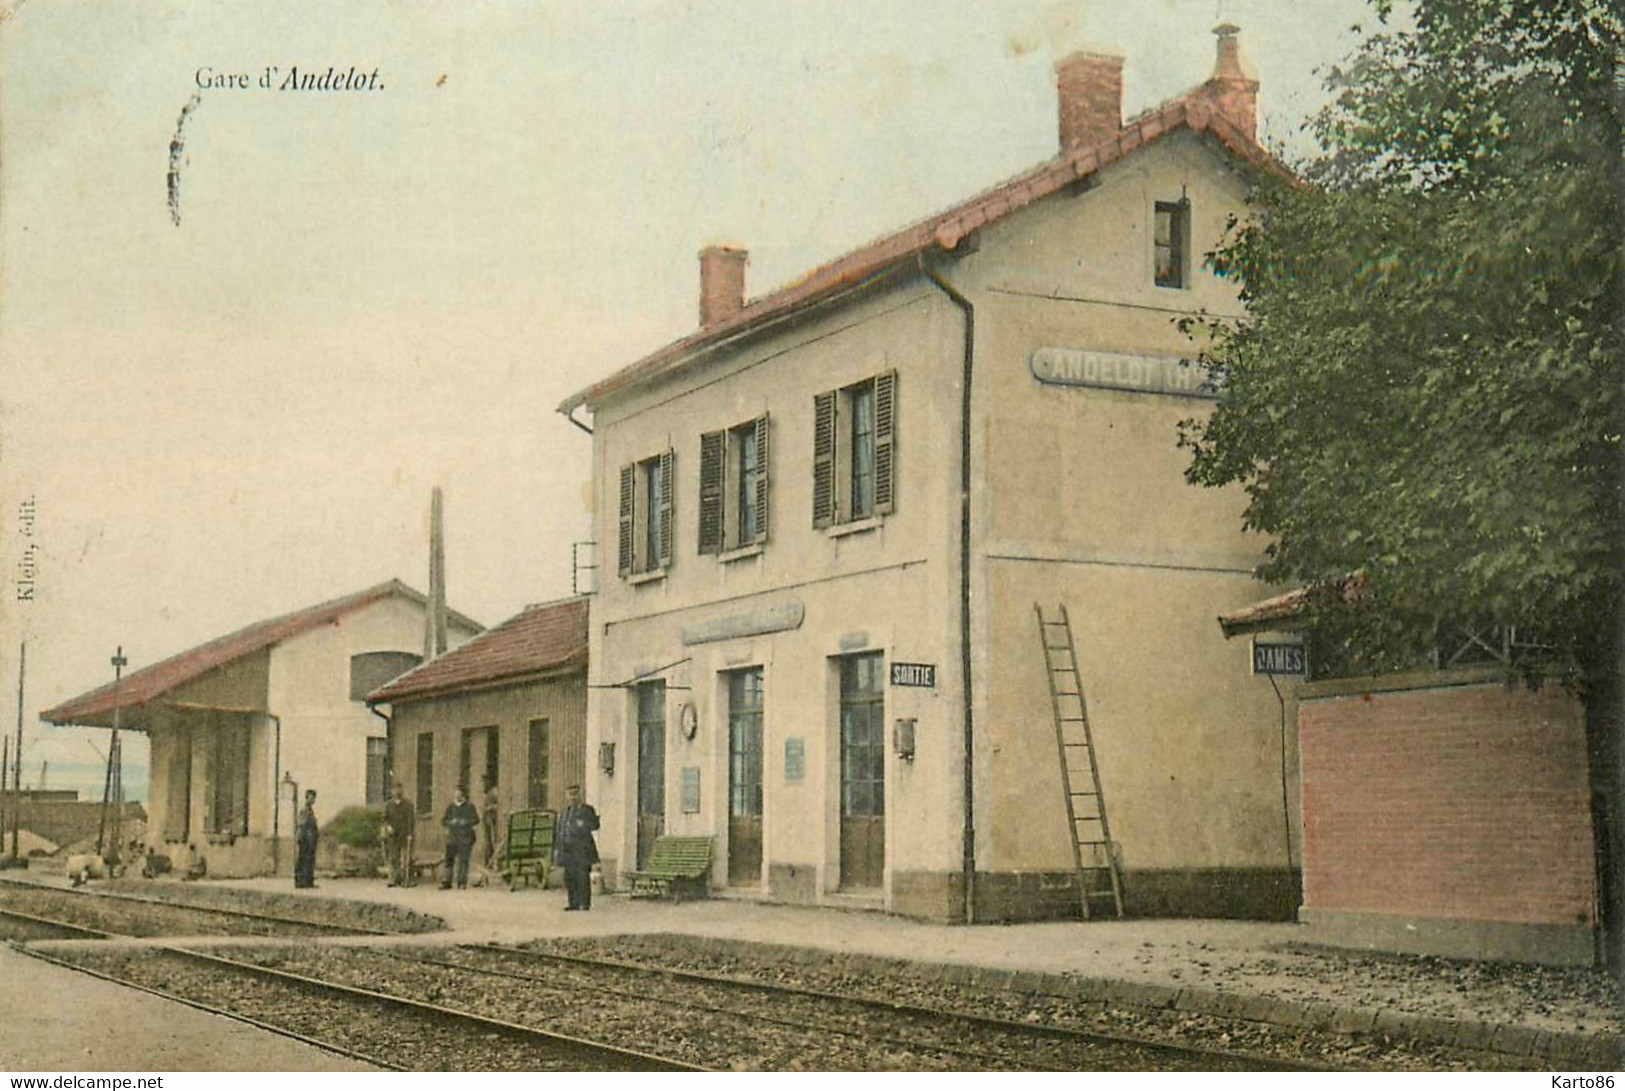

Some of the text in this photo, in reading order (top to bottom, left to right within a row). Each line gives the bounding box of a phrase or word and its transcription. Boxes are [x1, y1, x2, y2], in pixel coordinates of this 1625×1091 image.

[195, 66, 385, 91] Gare d'Andelot.
[1052, 353, 1155, 386] ANDELOT
[17, 495, 40, 601] Klein, édit.
[1257, 646, 1302, 671] DAMES
[894, 665, 932, 686] SORTIE
